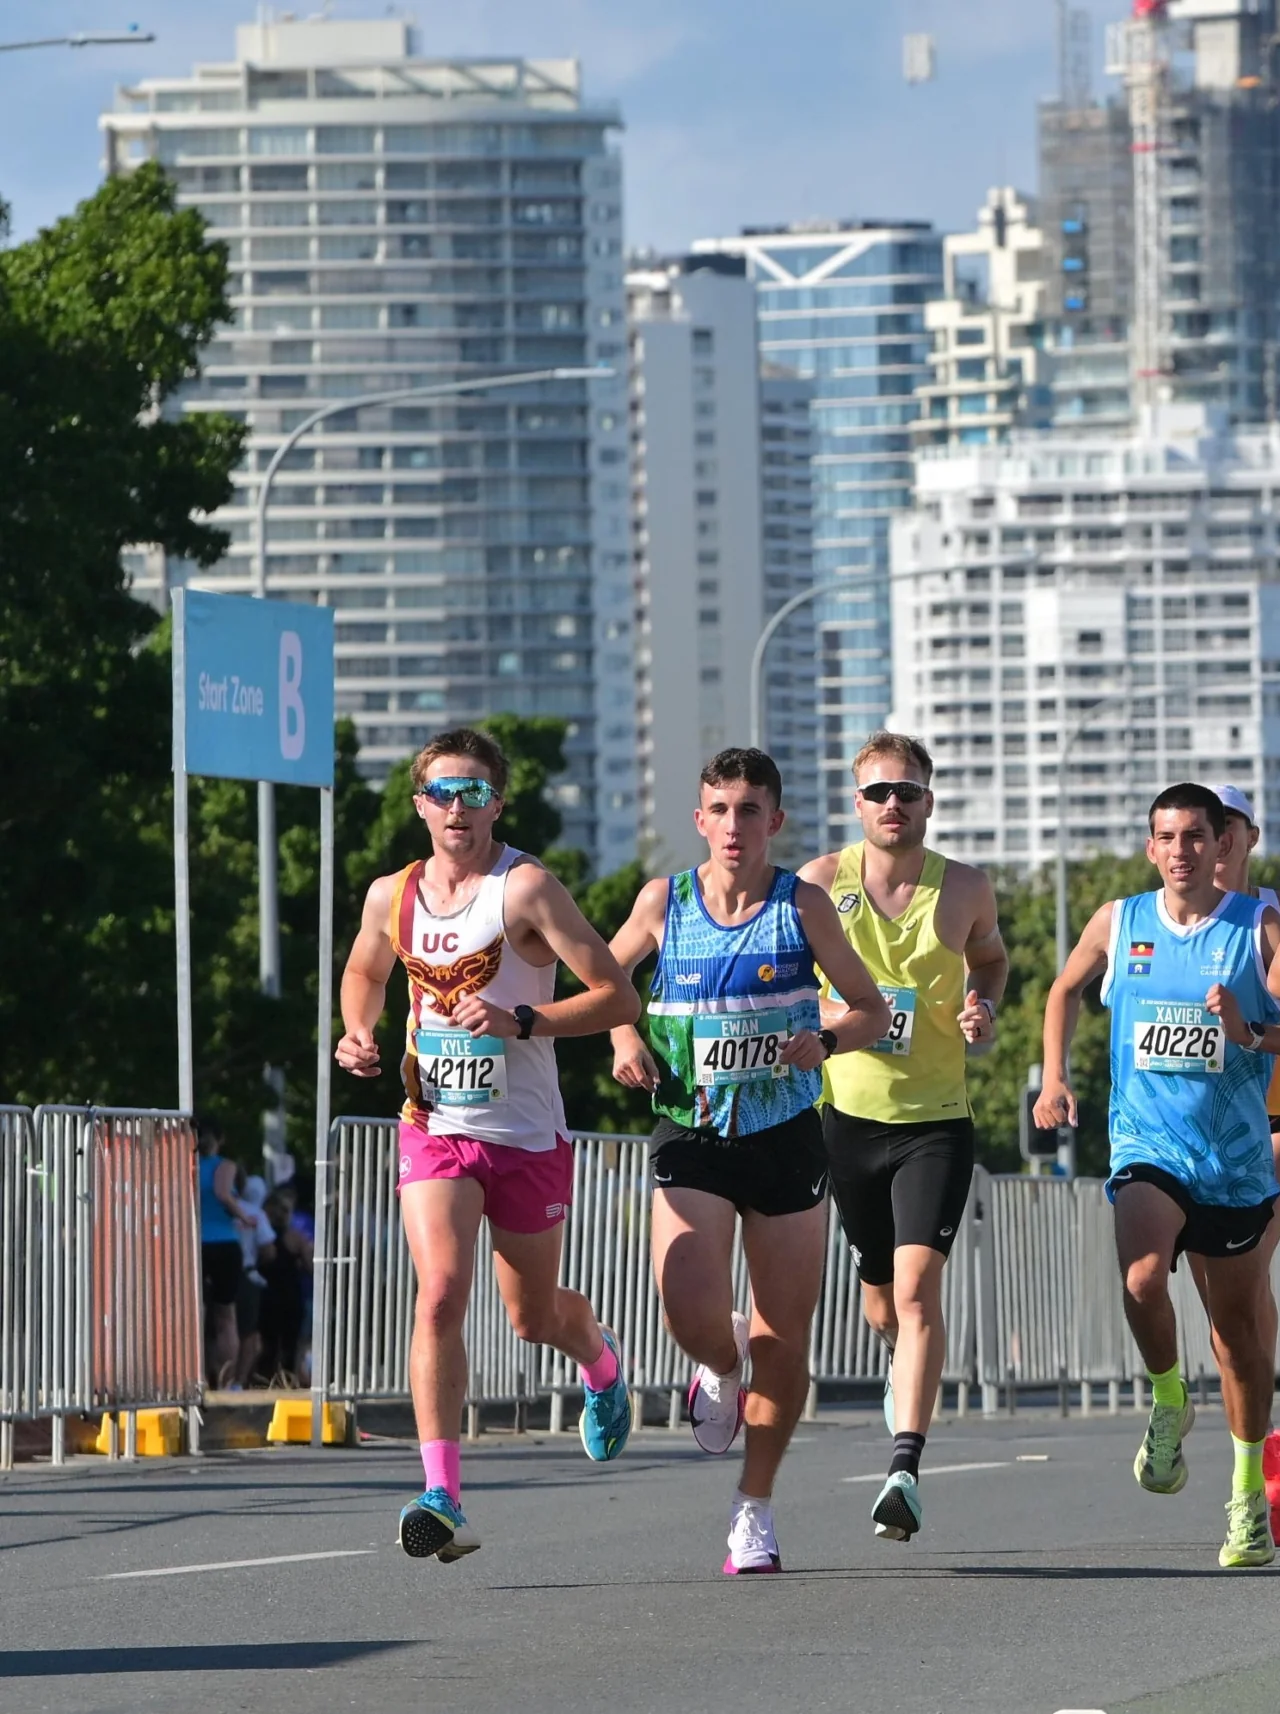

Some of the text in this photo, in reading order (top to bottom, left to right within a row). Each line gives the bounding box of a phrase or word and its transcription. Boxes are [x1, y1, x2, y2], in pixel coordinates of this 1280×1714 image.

[199, 630, 306, 760] Start Zone B
[422, 932, 459, 953] UC
[721, 1018, 759, 1036] EWAN
[1156, 1006, 1202, 1024] XAVIER
[441, 1039, 472, 1056] KYLE
[703, 1034, 779, 1070] 40178
[1139, 1025, 1219, 1058] 40226
[426, 1057, 494, 1089] 42112
